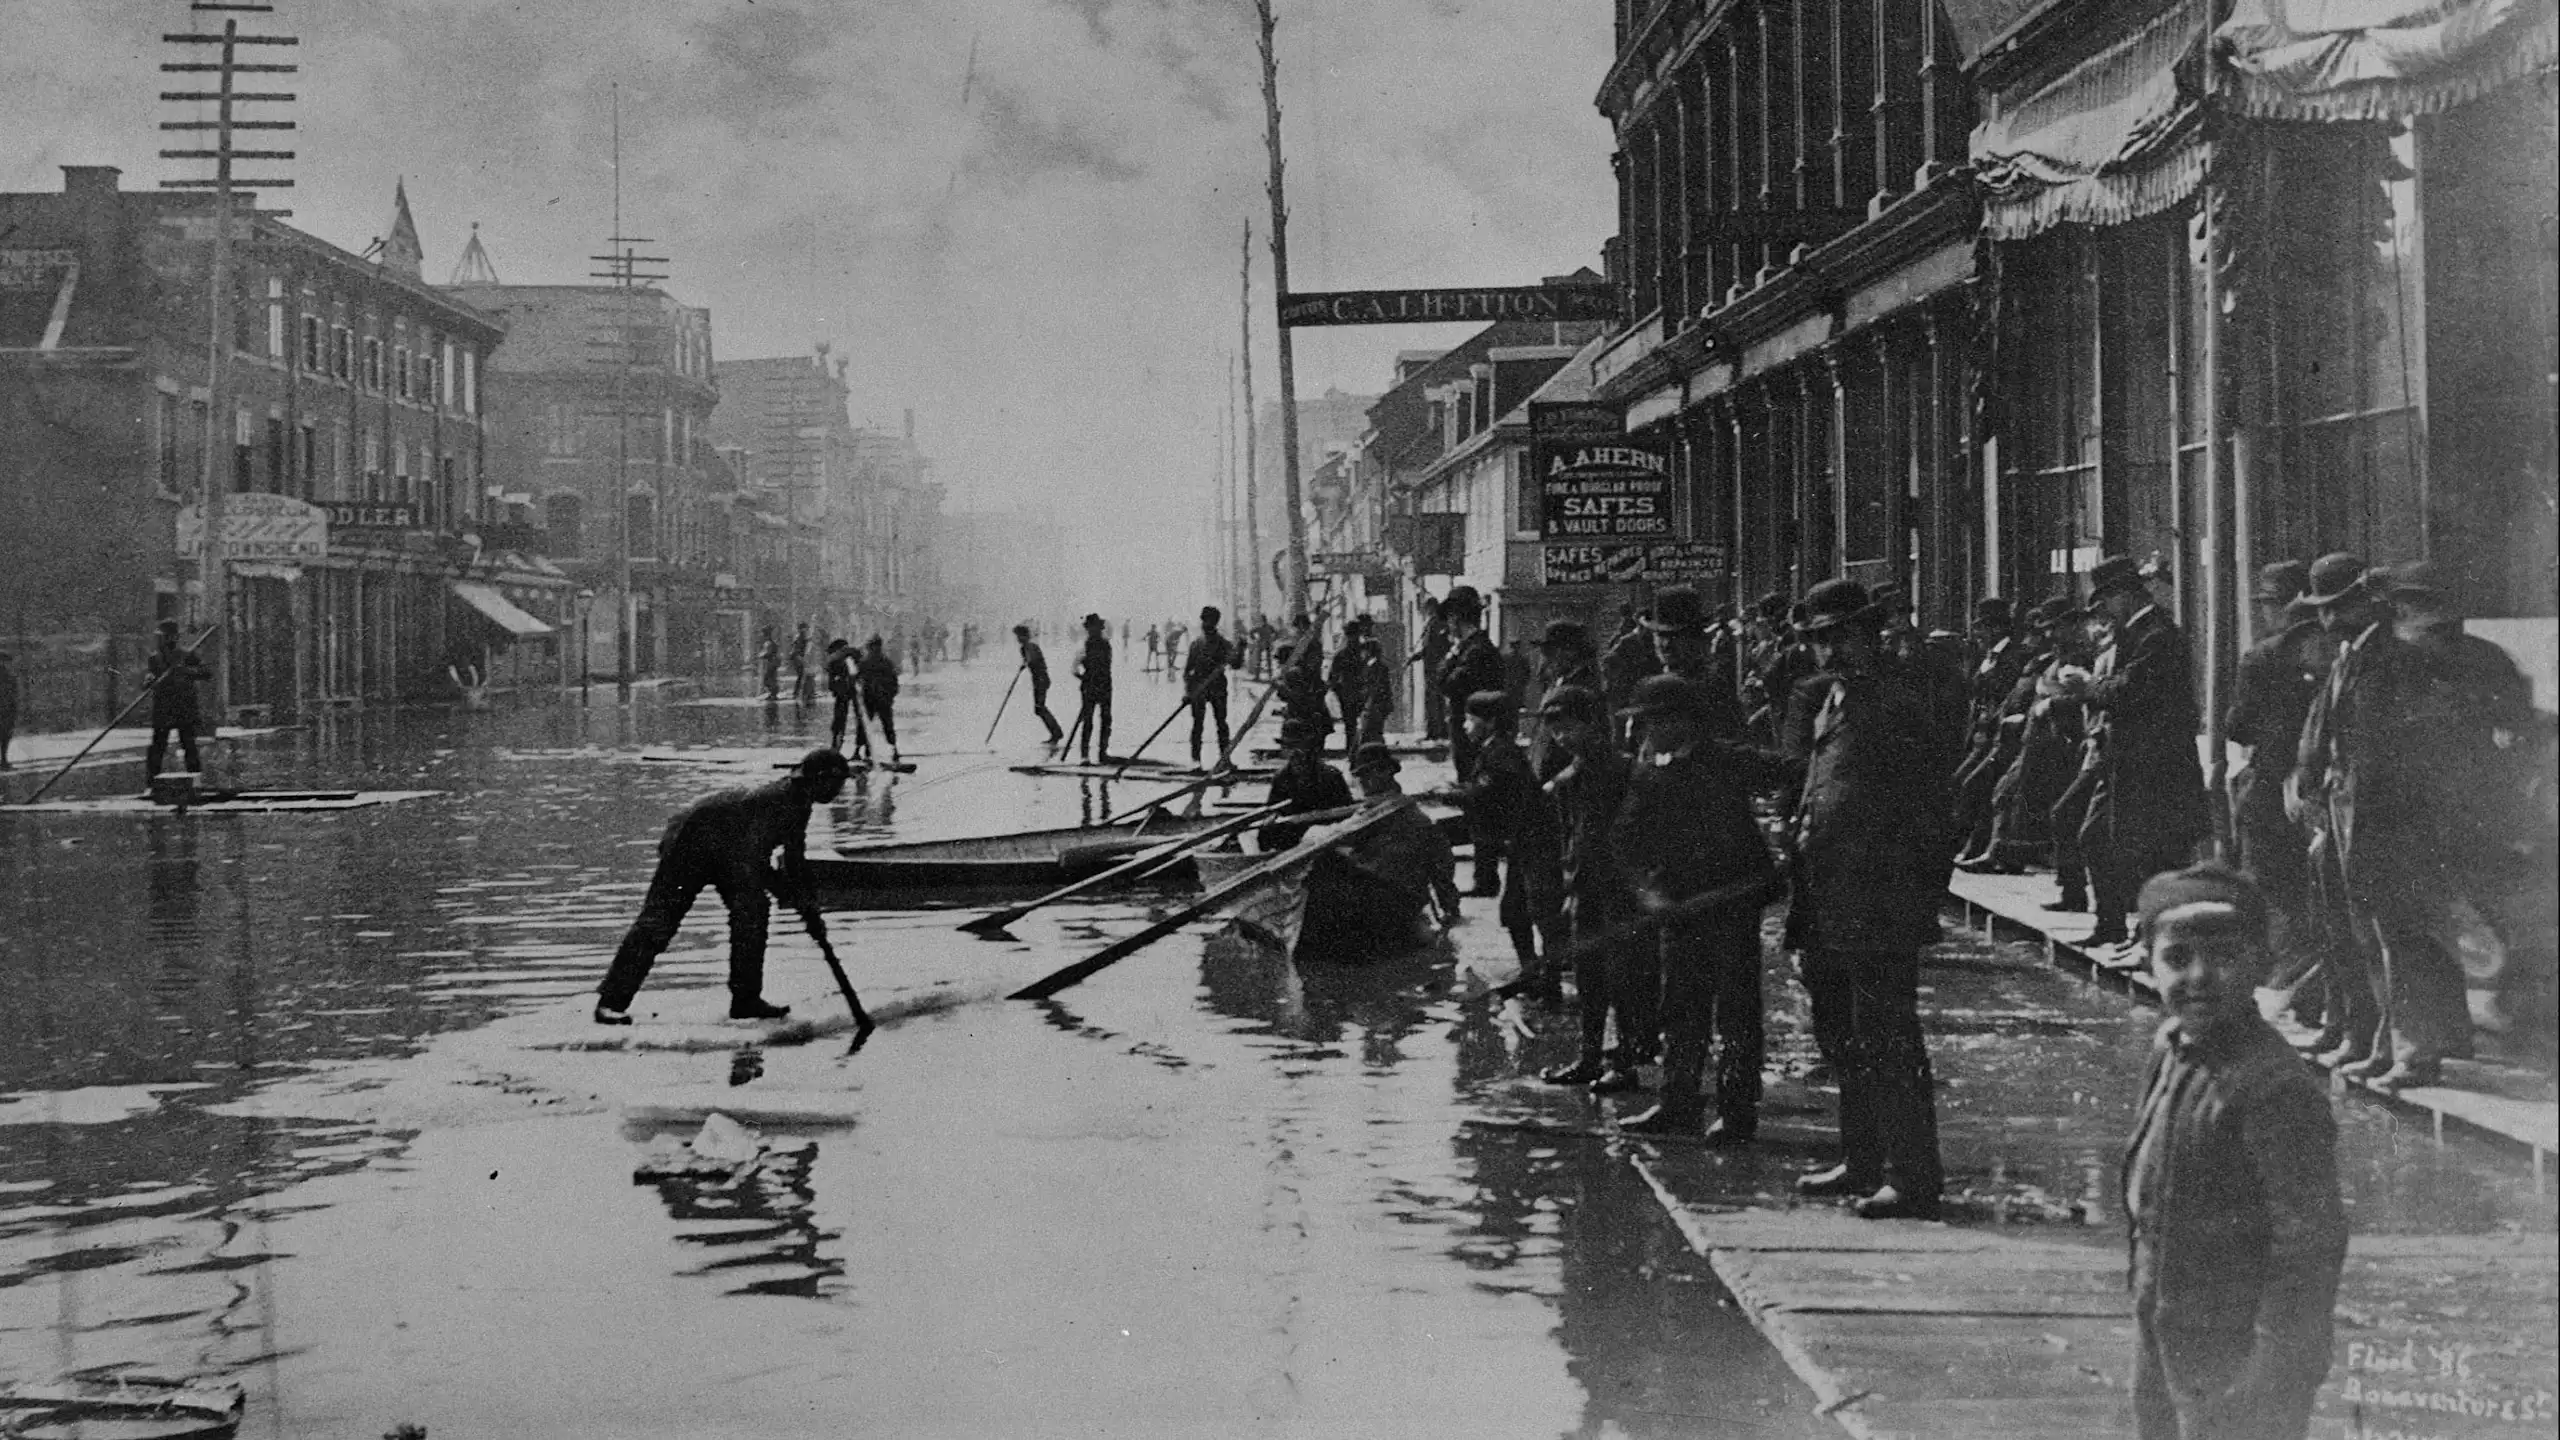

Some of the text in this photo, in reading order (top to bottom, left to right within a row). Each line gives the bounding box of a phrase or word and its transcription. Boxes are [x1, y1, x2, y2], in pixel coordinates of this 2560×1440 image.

[1574, 447, 1664, 472] AHERN
[1564, 497, 1655, 516] SAFES
[1549, 518, 1666, 534] & VAULT DOORS
[1546, 548, 1602, 564] SAFES
